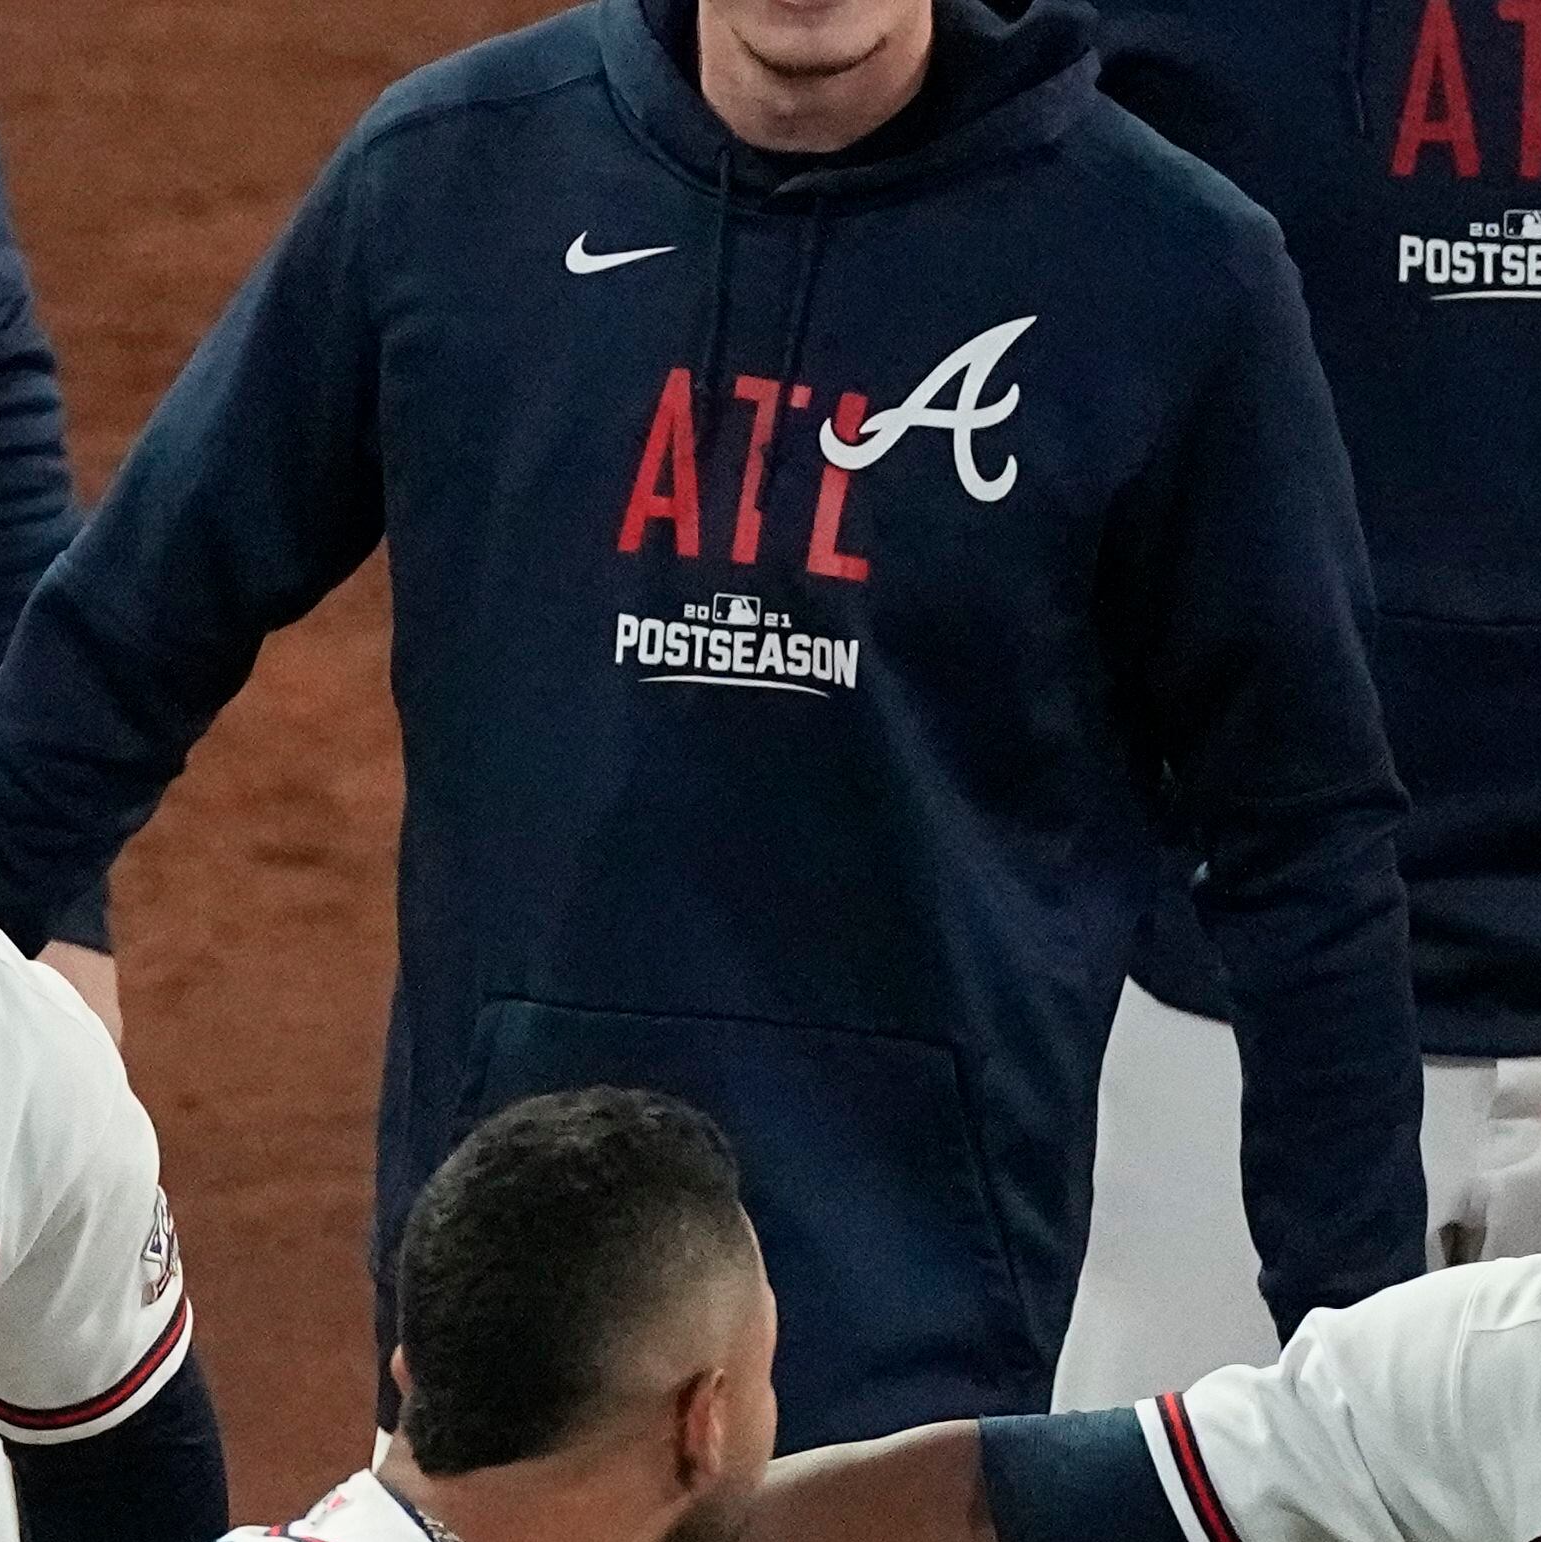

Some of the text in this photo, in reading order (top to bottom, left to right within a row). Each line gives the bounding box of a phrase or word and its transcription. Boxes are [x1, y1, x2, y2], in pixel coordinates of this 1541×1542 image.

[1469, 222, 1500, 238] 20
[616, 367, 869, 582] ATL
[684, 603, 792, 628] 20 21
[614, 613, 859, 689] POSTSEASON
